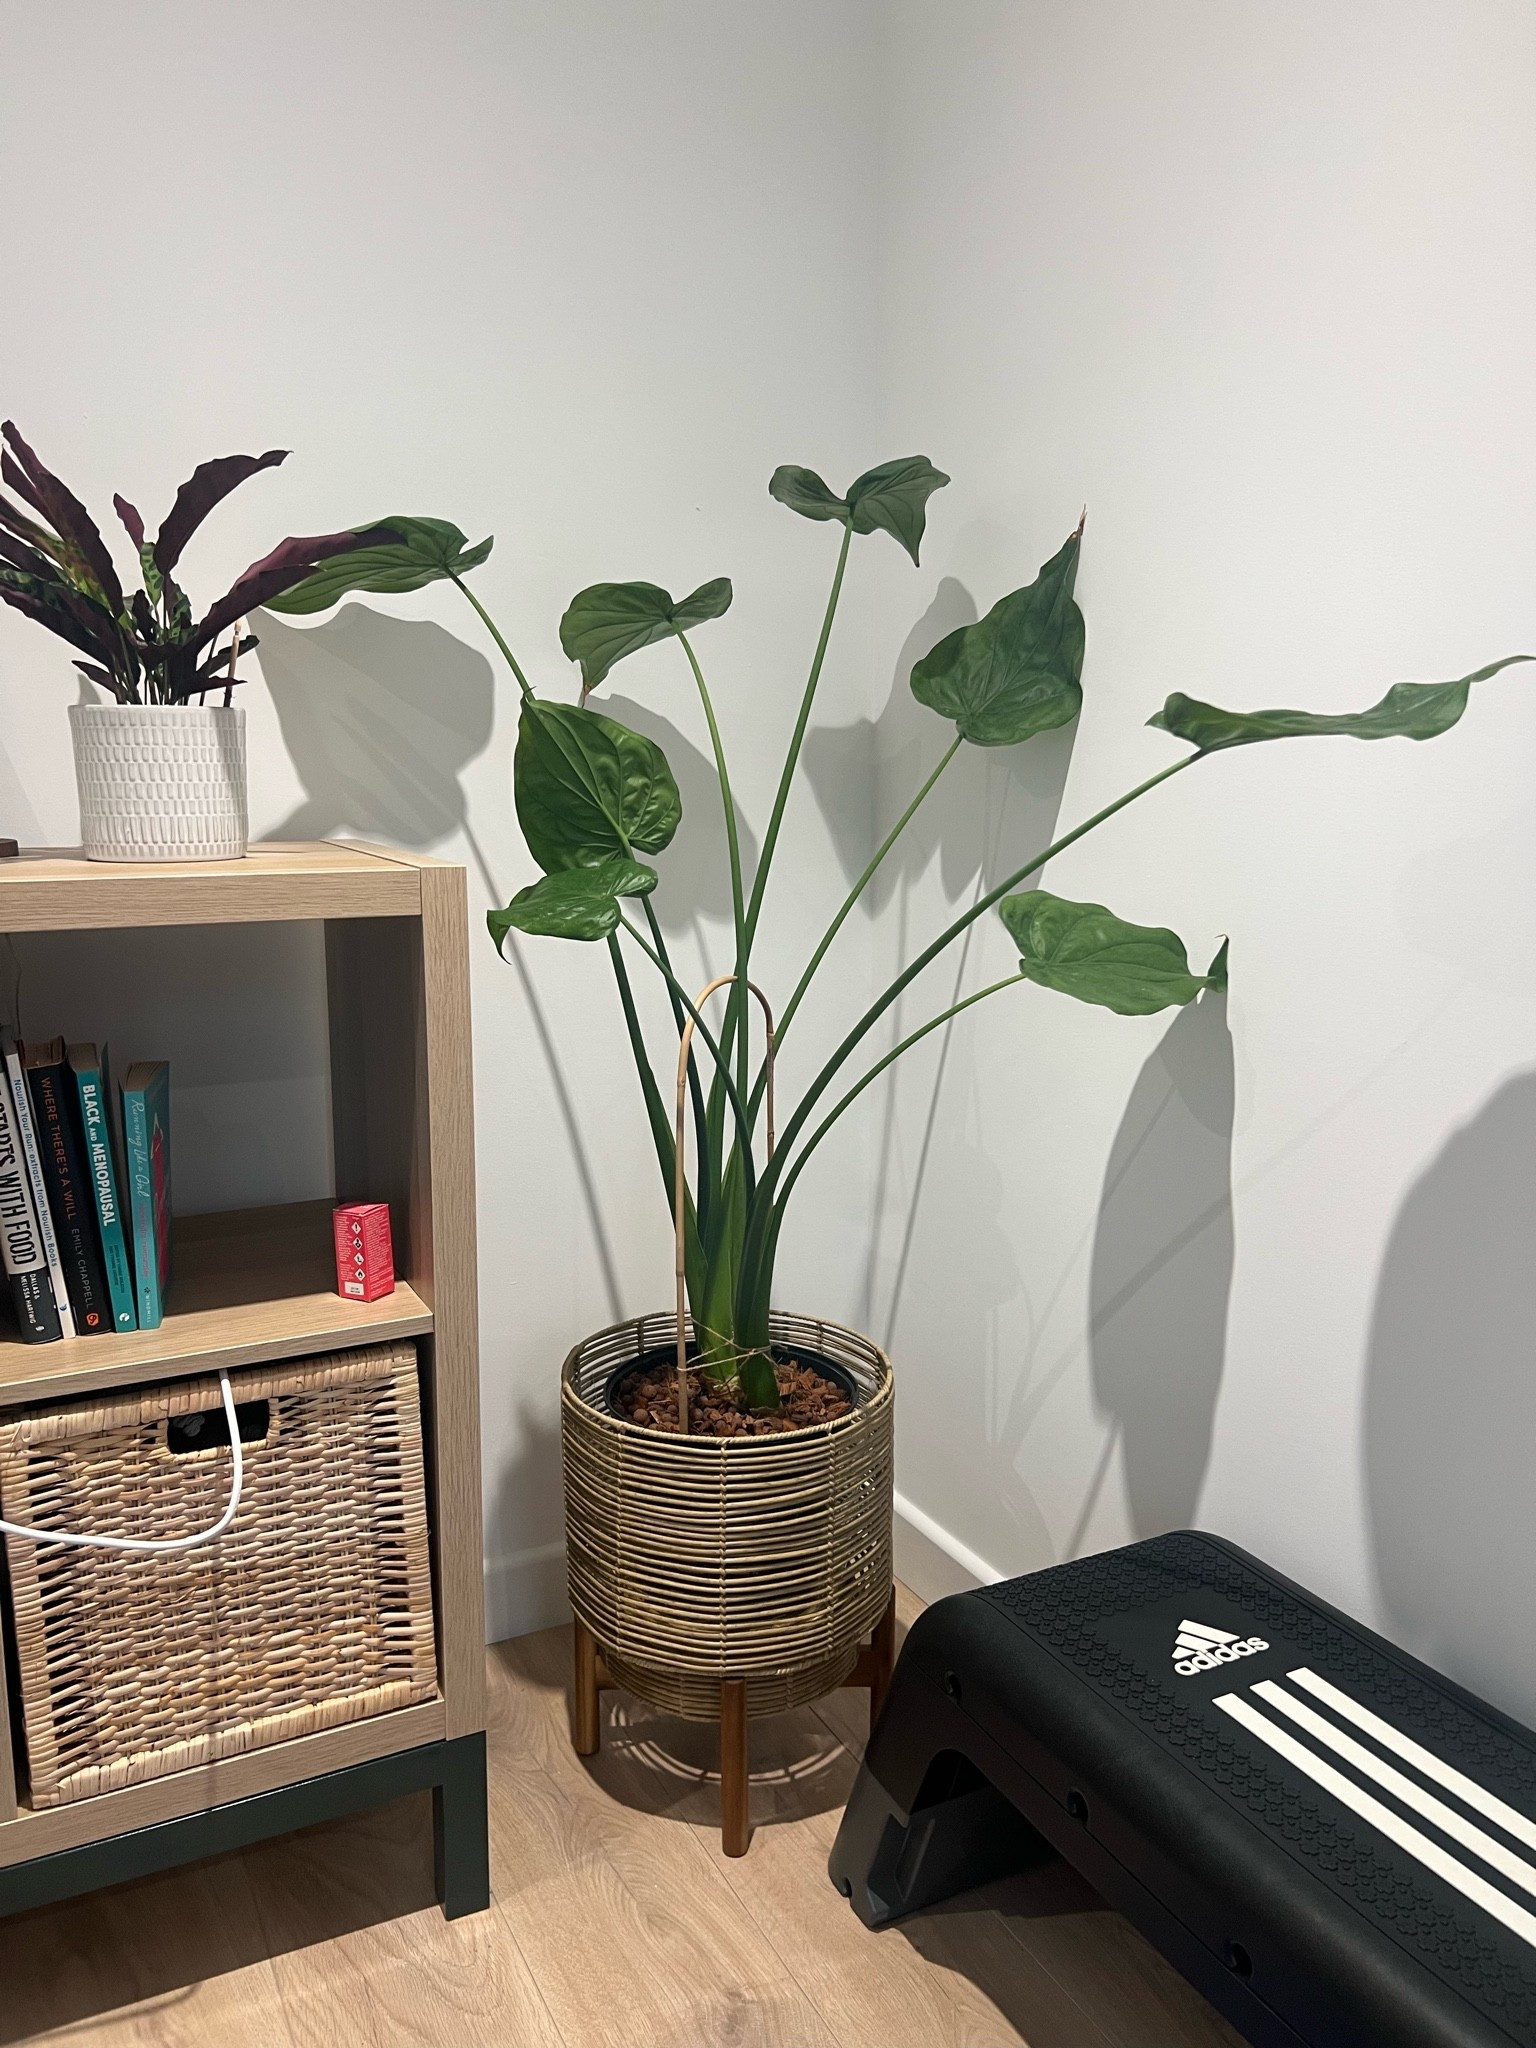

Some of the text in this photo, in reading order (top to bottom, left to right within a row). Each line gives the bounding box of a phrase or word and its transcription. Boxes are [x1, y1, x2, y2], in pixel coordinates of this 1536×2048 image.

[82, 1084, 101, 1126] BLACK
[127, 1099, 145, 1146] Running
[41, 1076, 77, 1221] WHERE THERE'S A WILL
[89, 1127, 98, 1142] AND
[0, 1170, 28, 1218] WITH
[13, 1079, 58, 1267] Nourish Your Run: extracts from Nourish Books
[91, 1143, 116, 1227] MENOPAUSAL
[135, 1174, 150, 1197] Girl
[4, 1220, 37, 1265] FOOD
[20, 1275, 31, 1299] MELISSA
[29, 1273, 40, 1295] DALLAS
[71, 1228, 94, 1309] EMILY CHAPPELL
[1174, 1636, 1270, 1676] adidas
